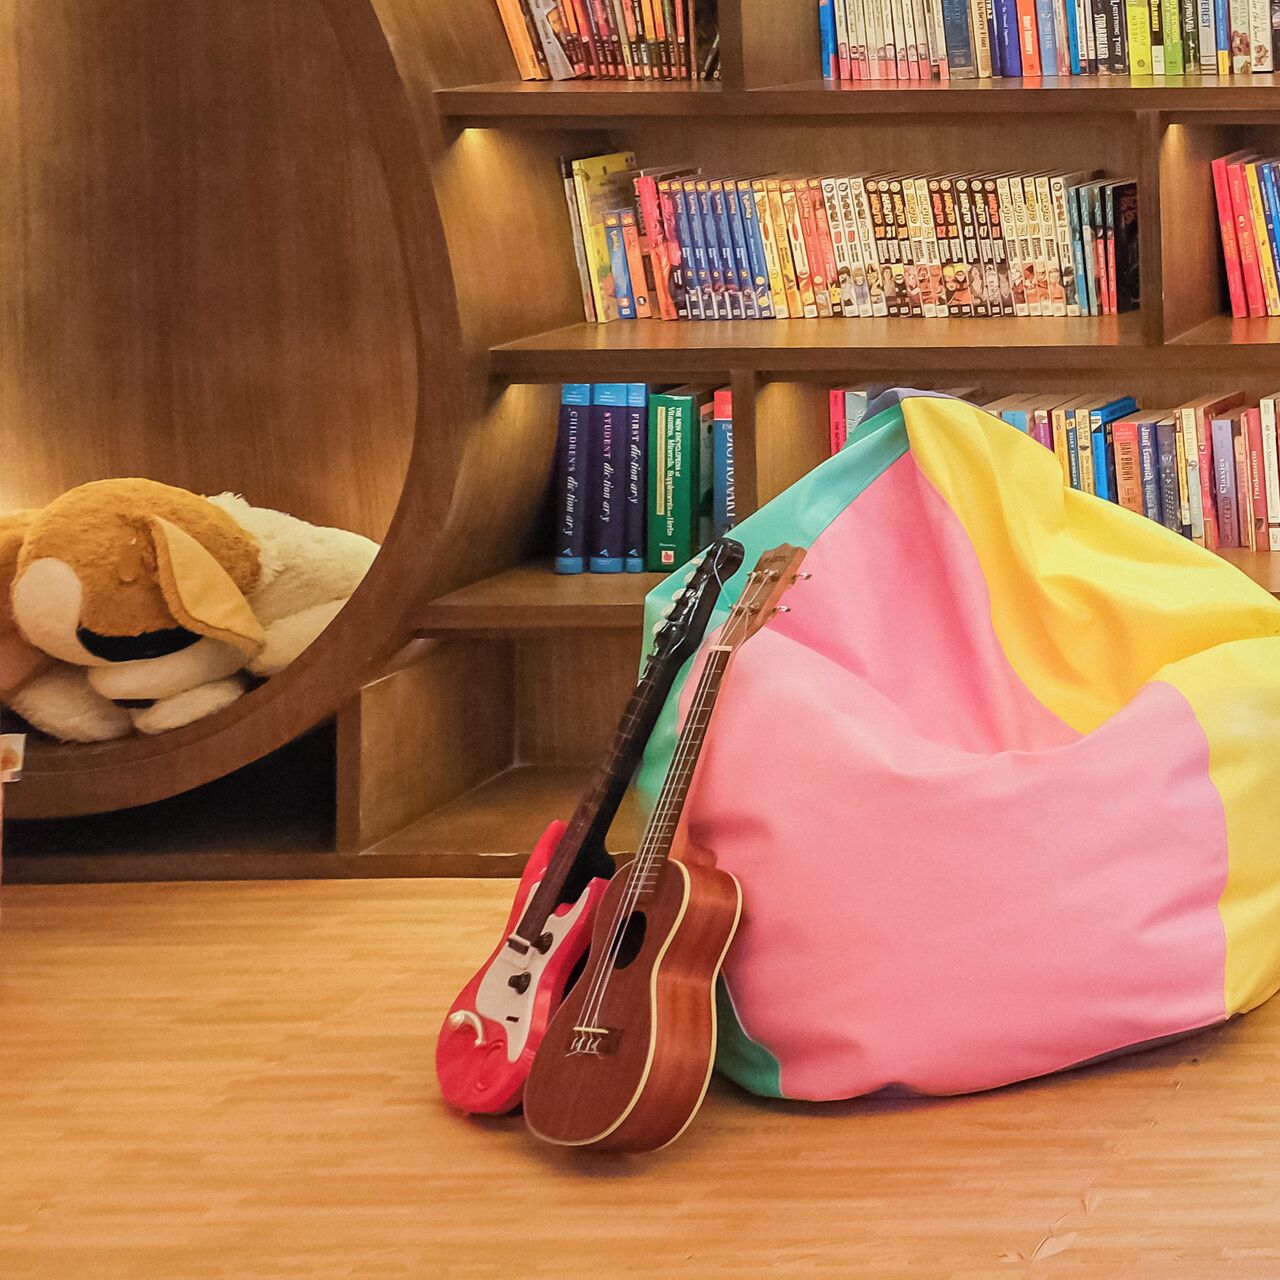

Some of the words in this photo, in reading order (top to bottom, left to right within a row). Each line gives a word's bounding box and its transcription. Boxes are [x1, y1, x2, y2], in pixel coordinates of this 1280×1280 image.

[1110, 0, 1120, 36] LIGHTNING
[1151, 0, 1159, 31] DIAMONDS
[1171, 16, 1179, 44] SCHOOL
[1113, 37, 1121, 56] THIEF
[870, 194, 881, 224] NARUTO
[881, 193, 893, 224] NARUTO
[892, 194, 905, 225] NARUTO
[906, 193, 918, 224] NARUTO
[918, 194, 930, 225] NARUTO
[932, 193, 944, 224] NARUTO
[944, 192, 955, 223] NARUTO
[959, 193, 972, 224] NARUTO
[973, 193, 986, 223] NARUTO
[987, 193, 999, 224] NARUTO
[1001, 192, 1014, 223] NARUTO
[1013, 192, 1025, 222] NARUTO
[1025, 191, 1037, 221] NARUTO
[1038, 191, 1050, 222] NARUTO
[568, 410, 578, 472] CHILDREN'S
[603, 411, 611, 459] STUDENT
[631, 413, 639, 442] FIRST
[1141, 427, 1150, 446] Janet
[1120, 442, 1132, 456] DAN
[1122, 457, 1134, 481] BROWN
[1142, 449, 1153, 481] Evanovich
[1252, 451, 1260, 499] Frankenstein
[665, 470, 674, 510] Supplements
